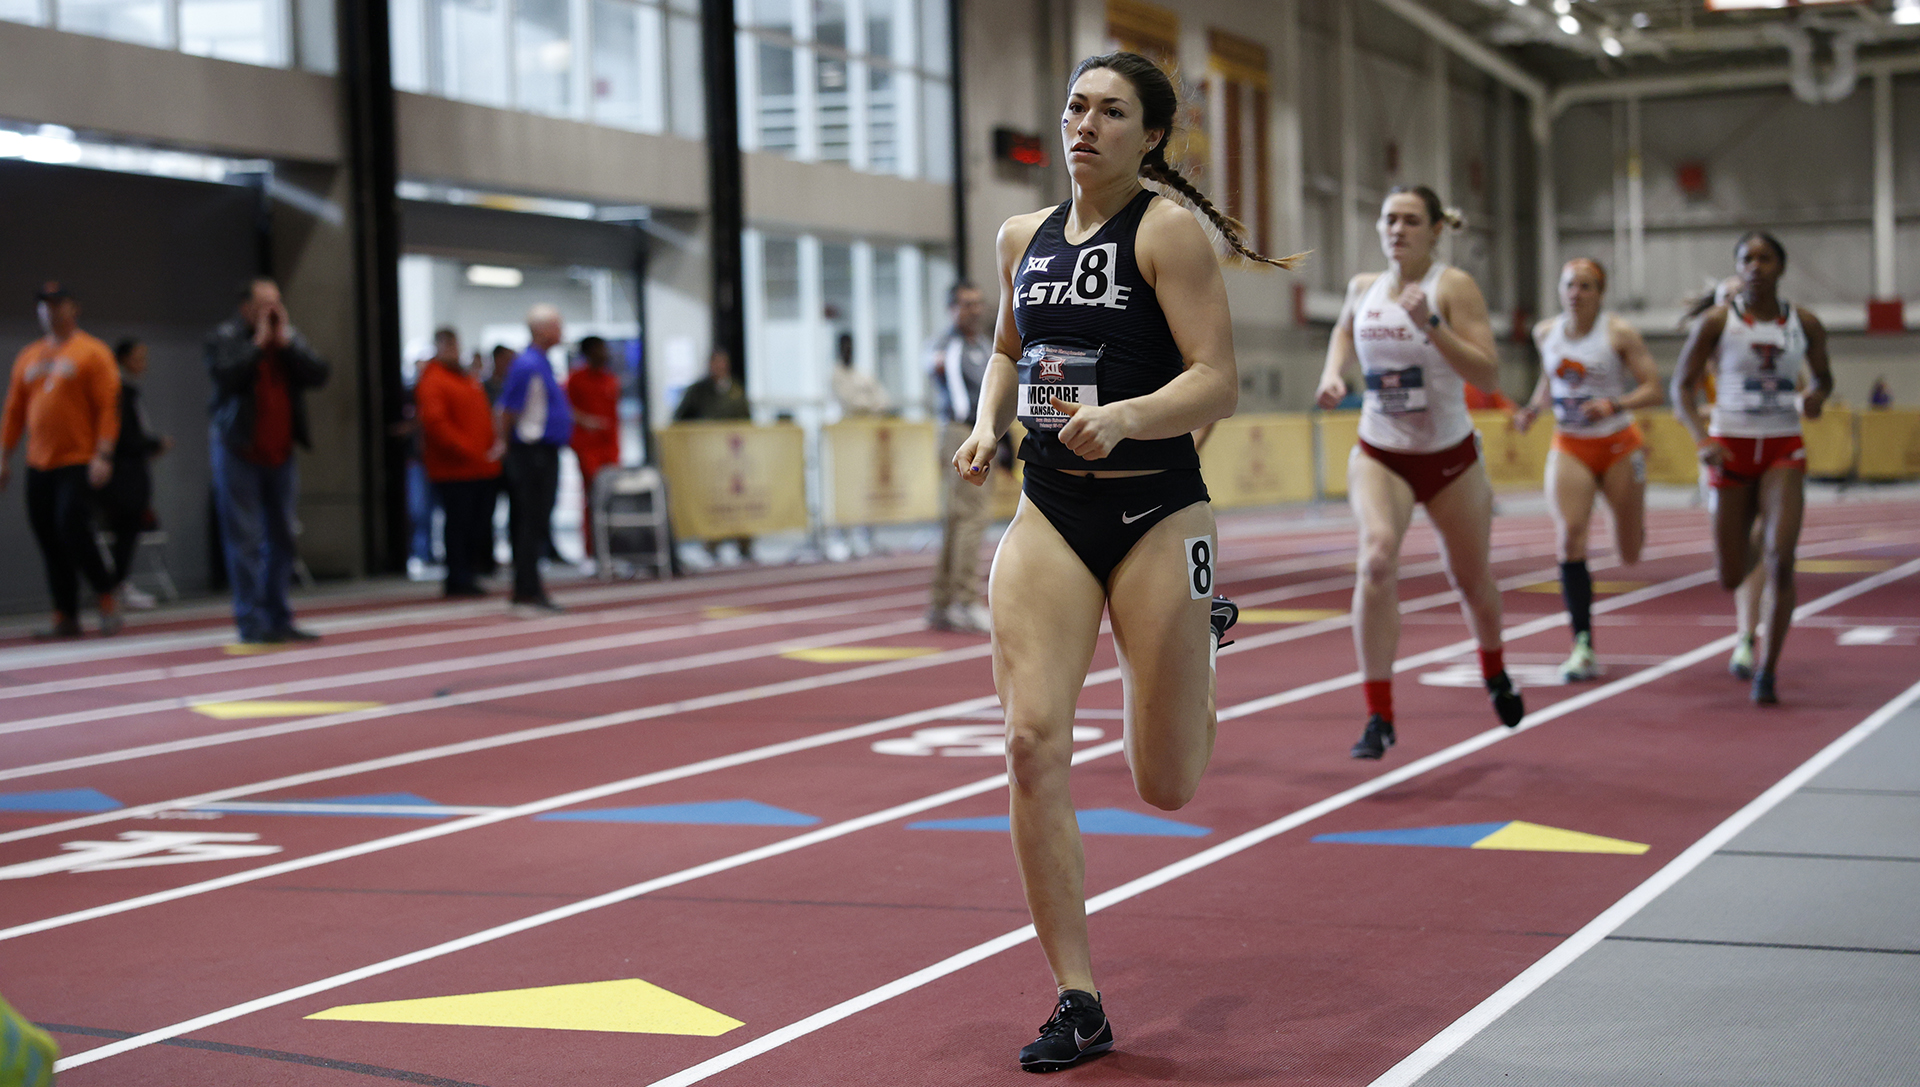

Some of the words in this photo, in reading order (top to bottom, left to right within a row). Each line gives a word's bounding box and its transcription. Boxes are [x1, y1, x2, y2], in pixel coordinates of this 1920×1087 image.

[1076, 248, 1108, 300] 8
[1013, 281, 1132, 310] K-STAE
[1030, 406, 1055, 416] KANSAS
[1191, 540, 1211, 595] 8
